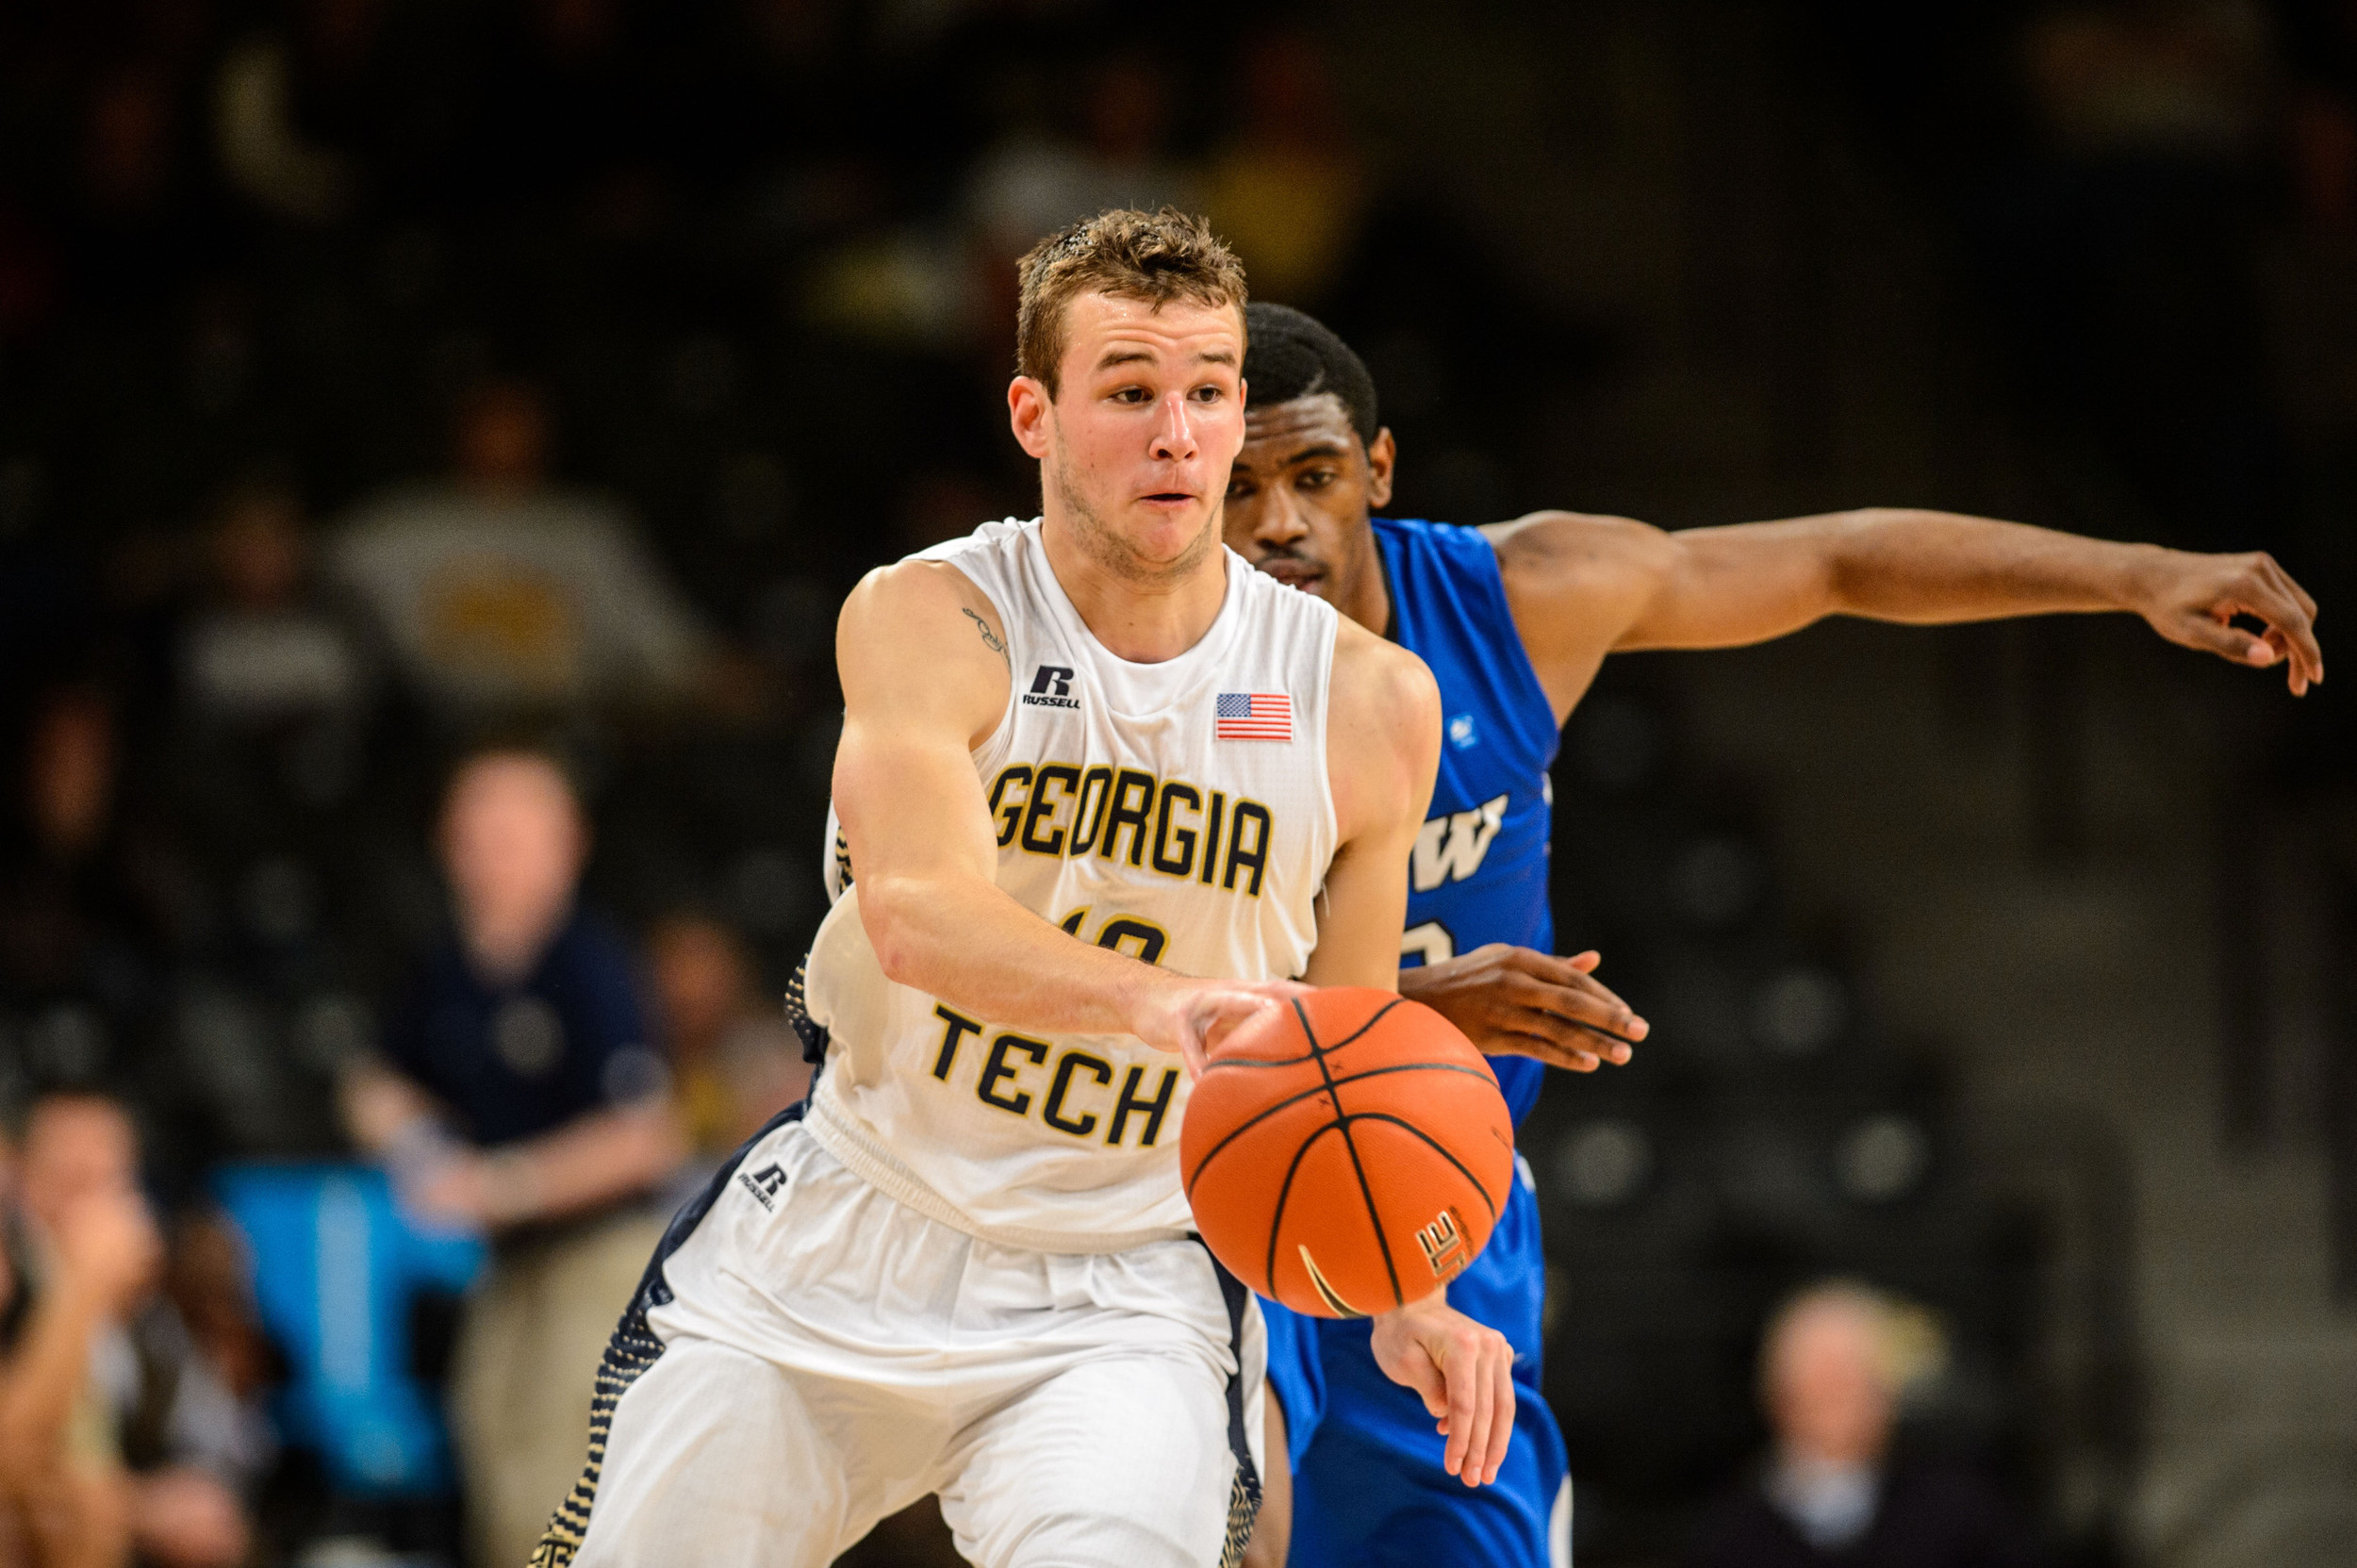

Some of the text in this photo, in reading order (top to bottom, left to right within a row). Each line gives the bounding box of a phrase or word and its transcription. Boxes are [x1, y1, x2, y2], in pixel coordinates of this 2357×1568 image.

[1030, 665, 1074, 697] R
[1023, 694, 1080, 709] RUSSELL
[987, 761, 1275, 899] GEORGIA
[931, 1000, 1182, 1148] TECH
[738, 1172, 775, 1213] RUSSELL
[753, 1162, 788, 1197] R
